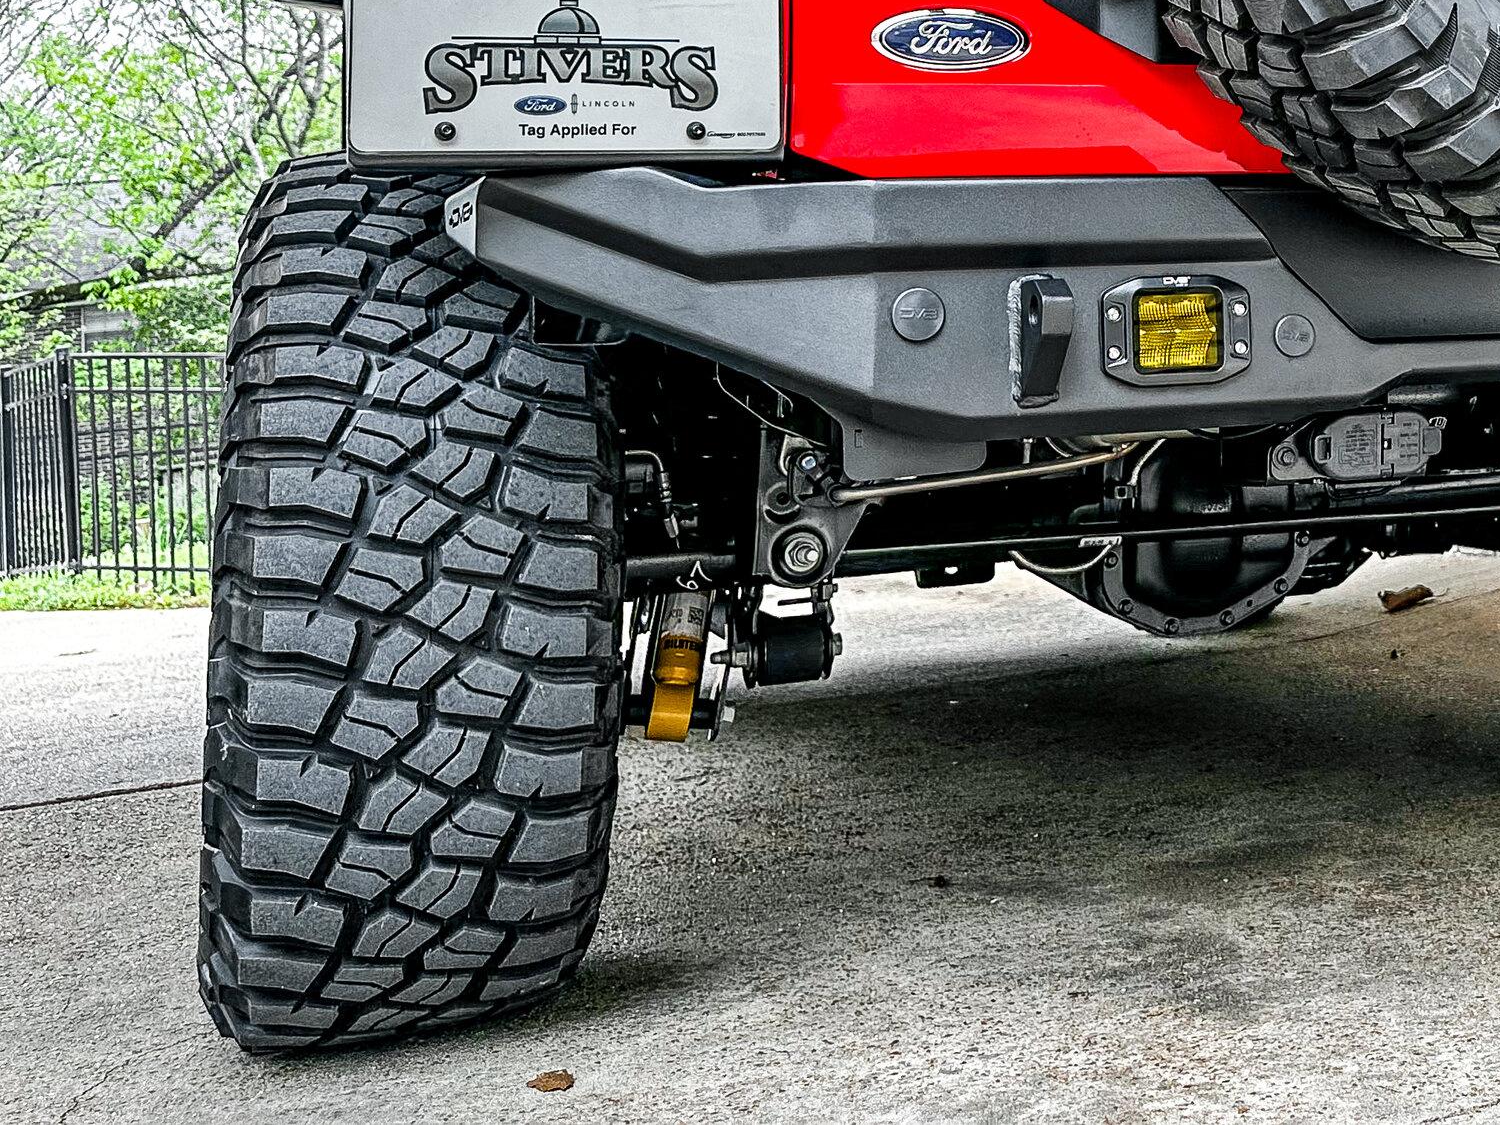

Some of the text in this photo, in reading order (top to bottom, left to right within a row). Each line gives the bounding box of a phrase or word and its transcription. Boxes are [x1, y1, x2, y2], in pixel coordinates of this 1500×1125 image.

[910, 20, 994, 55] Ford
[422, 42, 719, 115] STIVERS
[523, 98, 556, 112] Ford
[582, 100, 636, 108] LINCOLN
[518, 123, 637, 139] Tag Applied For
